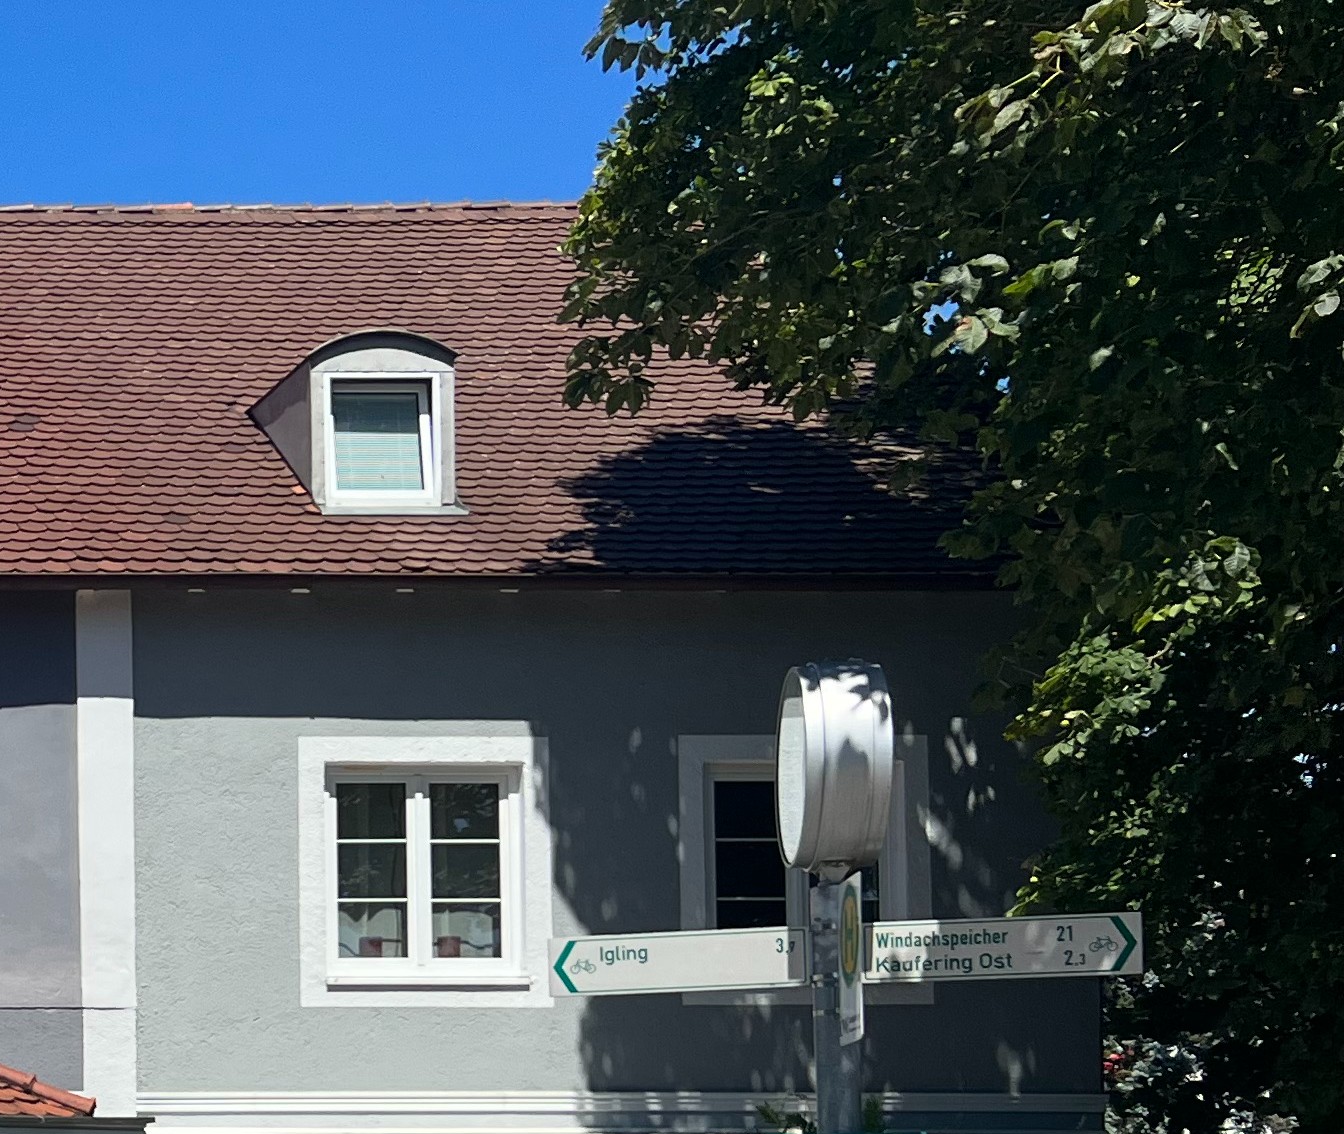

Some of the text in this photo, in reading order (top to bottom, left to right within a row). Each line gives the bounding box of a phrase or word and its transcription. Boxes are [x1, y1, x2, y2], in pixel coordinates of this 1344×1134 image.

[875, 925, 1073, 950] Windachspeicher 21
[599, 945, 648, 965] Igling
[876, 954, 973, 973] Kaufering
[979, 952, 1013, 969] Ost
